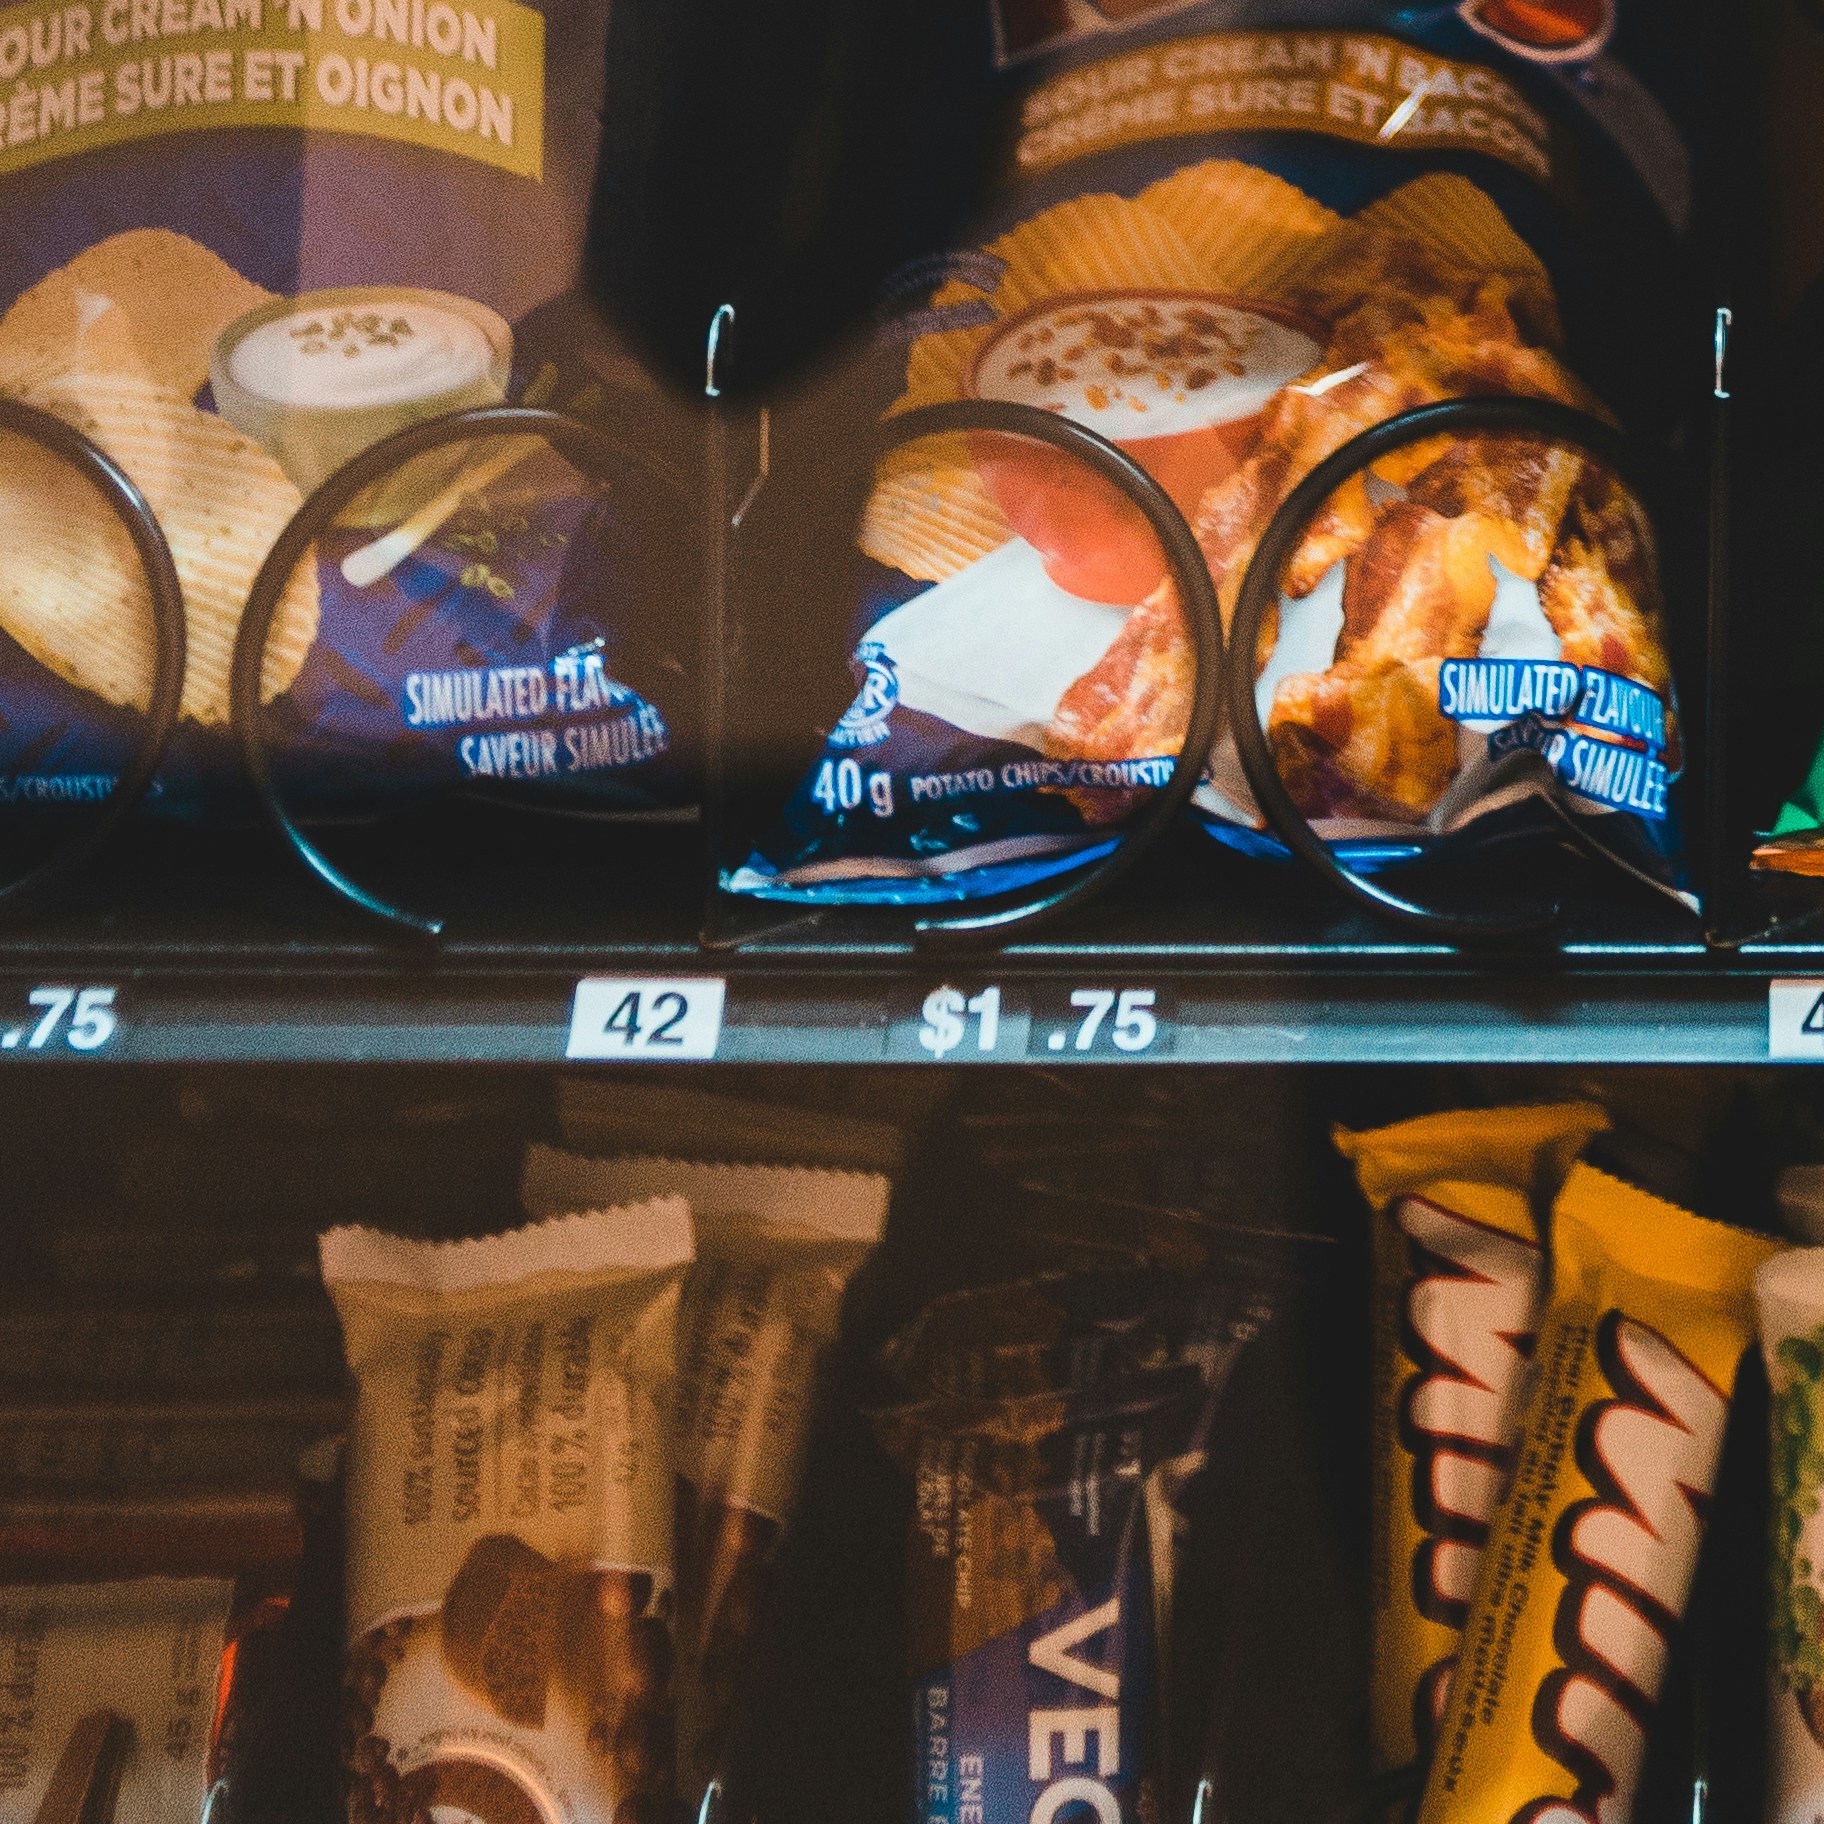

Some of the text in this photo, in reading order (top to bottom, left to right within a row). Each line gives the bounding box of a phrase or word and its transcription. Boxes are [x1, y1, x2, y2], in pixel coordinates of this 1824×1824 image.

[114, 50, 515, 147] SURE ET OIGNON
[406, 665, 548, 727] SIMULATED
[1442, 662, 1580, 715] SIMULATED
[812, 758, 997, 819] 40 g POTATO
[1, 987, 119, 1051] .75
[603, 991, 691, 1046] 42
[919, 987, 1157, 1057] $1 .75
